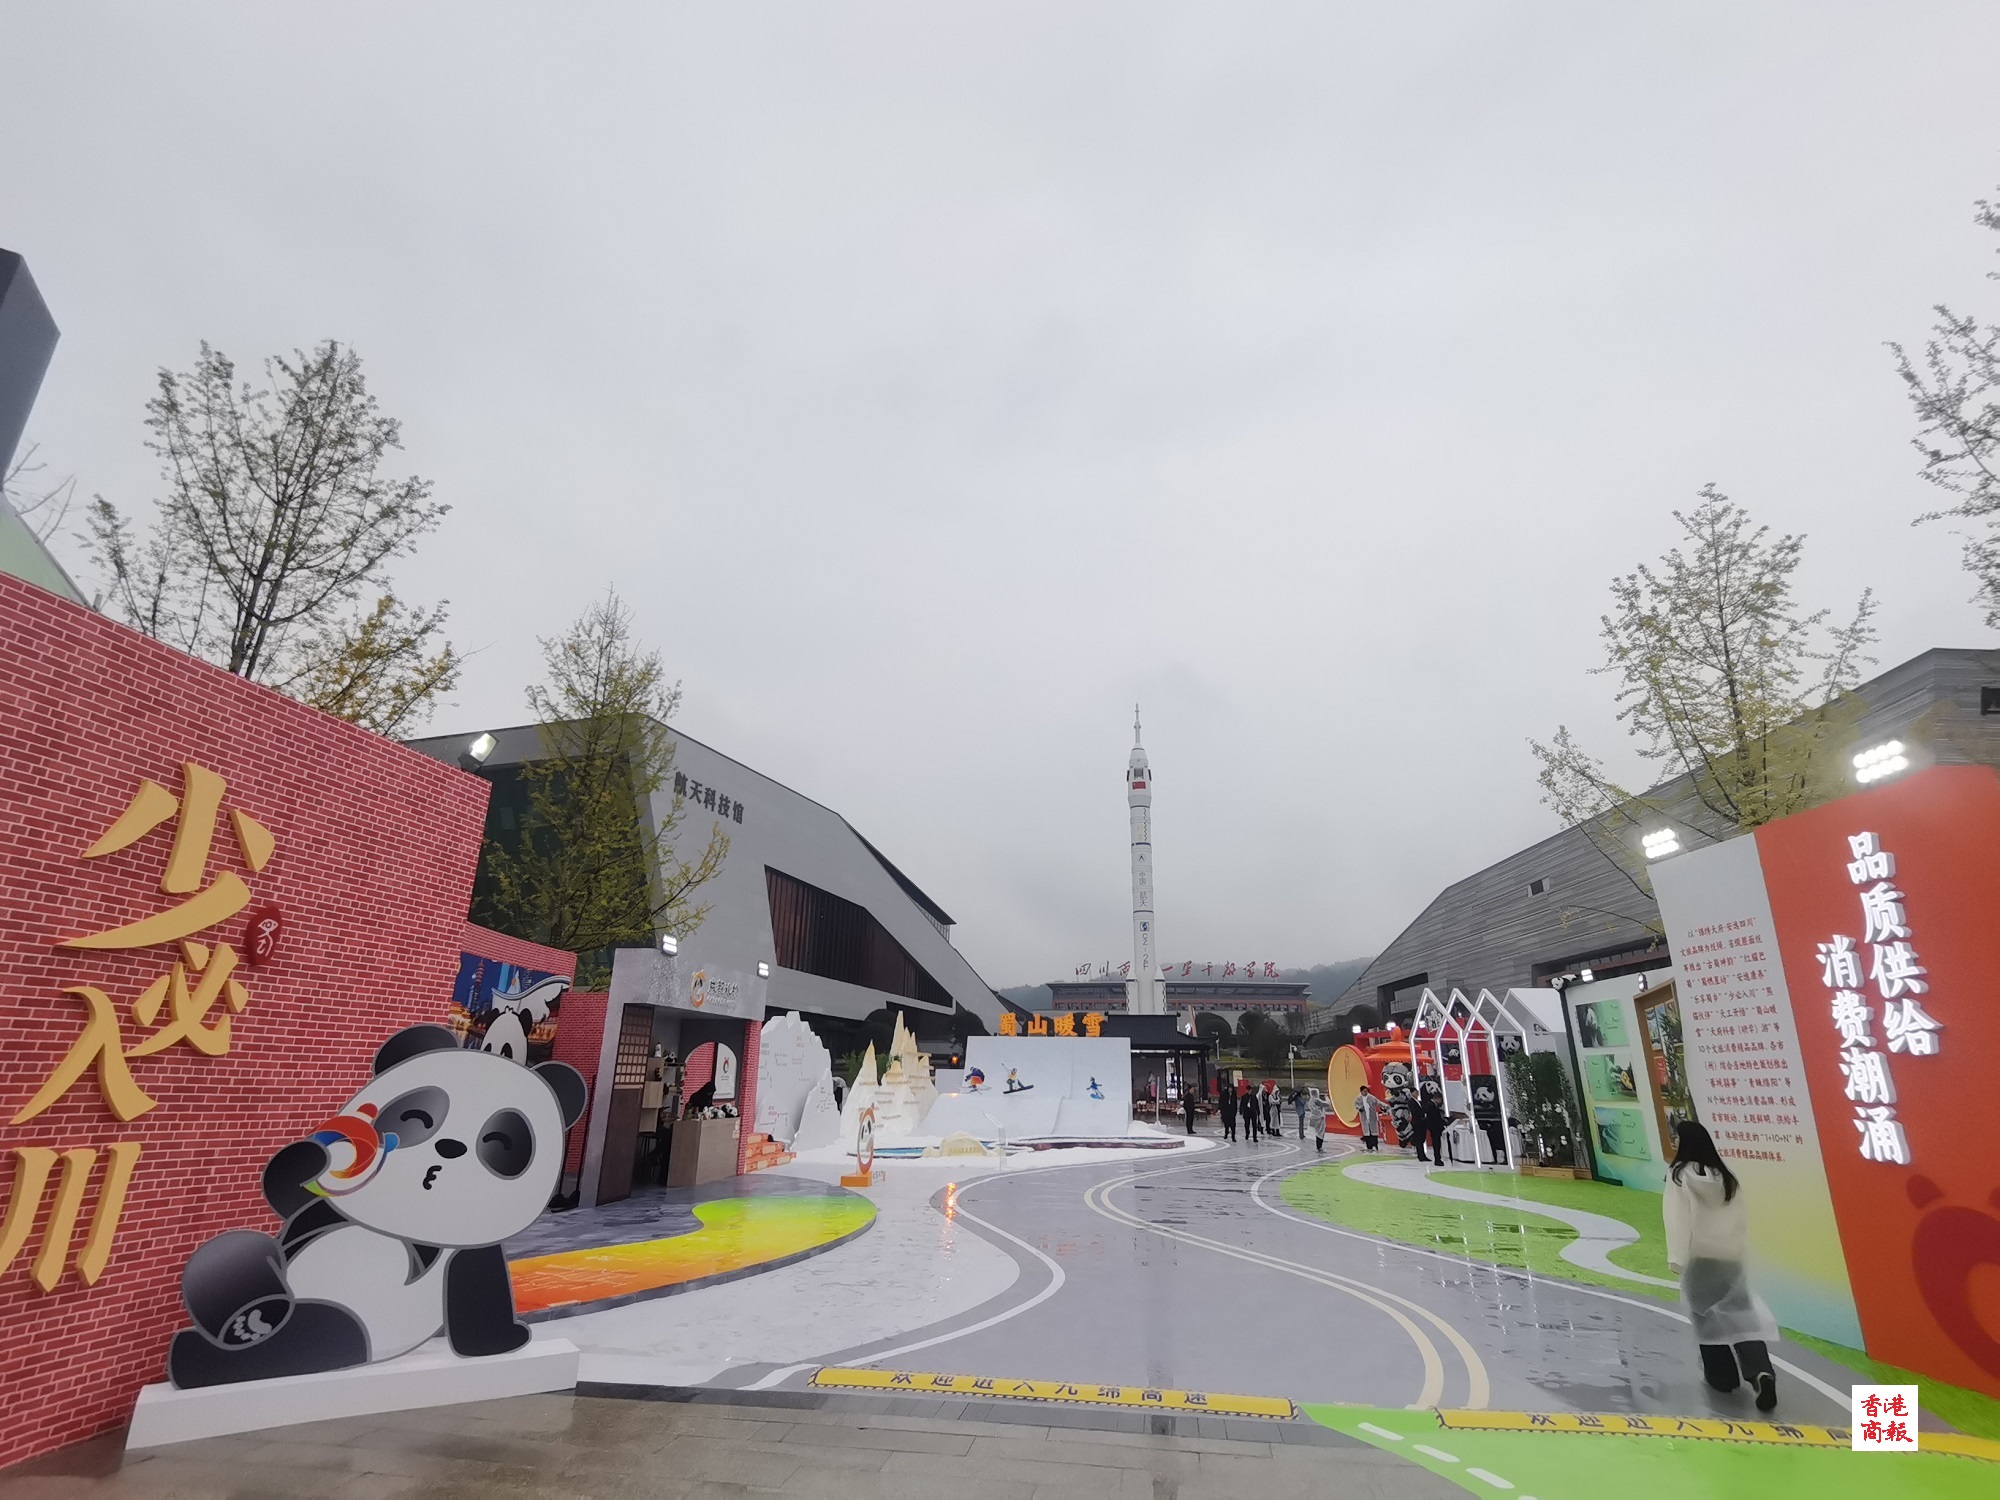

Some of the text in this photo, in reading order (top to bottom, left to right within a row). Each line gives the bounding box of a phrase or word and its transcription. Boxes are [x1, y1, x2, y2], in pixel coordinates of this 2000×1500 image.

[674, 771, 744, 824] 航天科技馆
[1138, 871, 1148, 907] 中国航天
[1847, 831, 1944, 1056] 品质供给
[0, 761, 276, 1293] 少必入川
[998, 1012, 1105, 1037] 蜀山暖雪
[1816, 934, 1911, 1165] 消费潮涌
[891, 1373, 1208, 1405] 欢迎进入九绵高速
